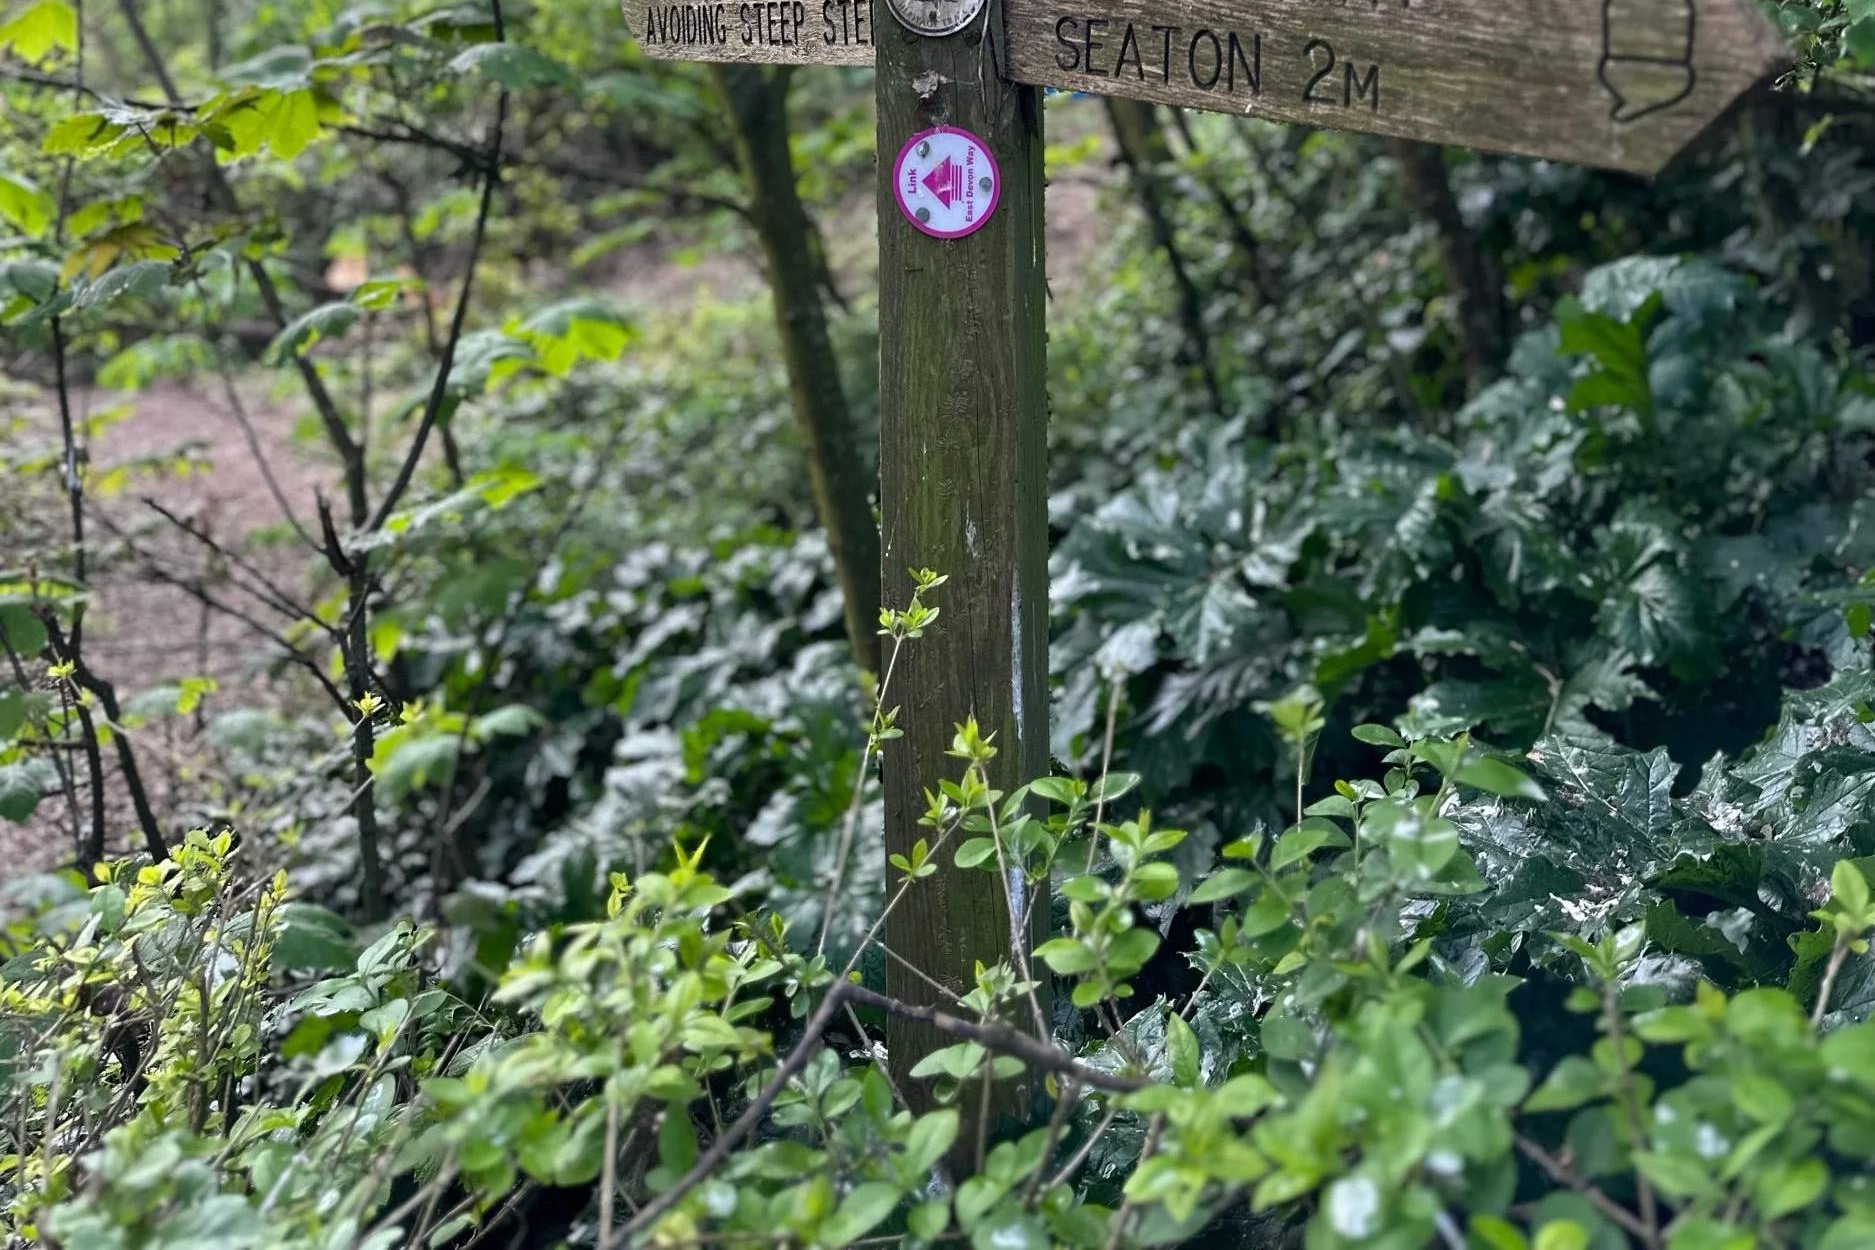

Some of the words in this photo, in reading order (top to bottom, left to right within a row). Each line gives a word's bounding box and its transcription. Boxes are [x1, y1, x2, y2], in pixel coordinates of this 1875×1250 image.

[646, 4, 727, 45] AVOIDING
[740, 1, 805, 46] STEEP
[1055, 16, 1261, 96] SEATON
[1302, 39, 1380, 112] 2M
[966, 145, 976, 166] Way
[908, 169, 917, 194] Link
[966, 168, 974, 198] Devon
[965, 200, 974, 222] East
